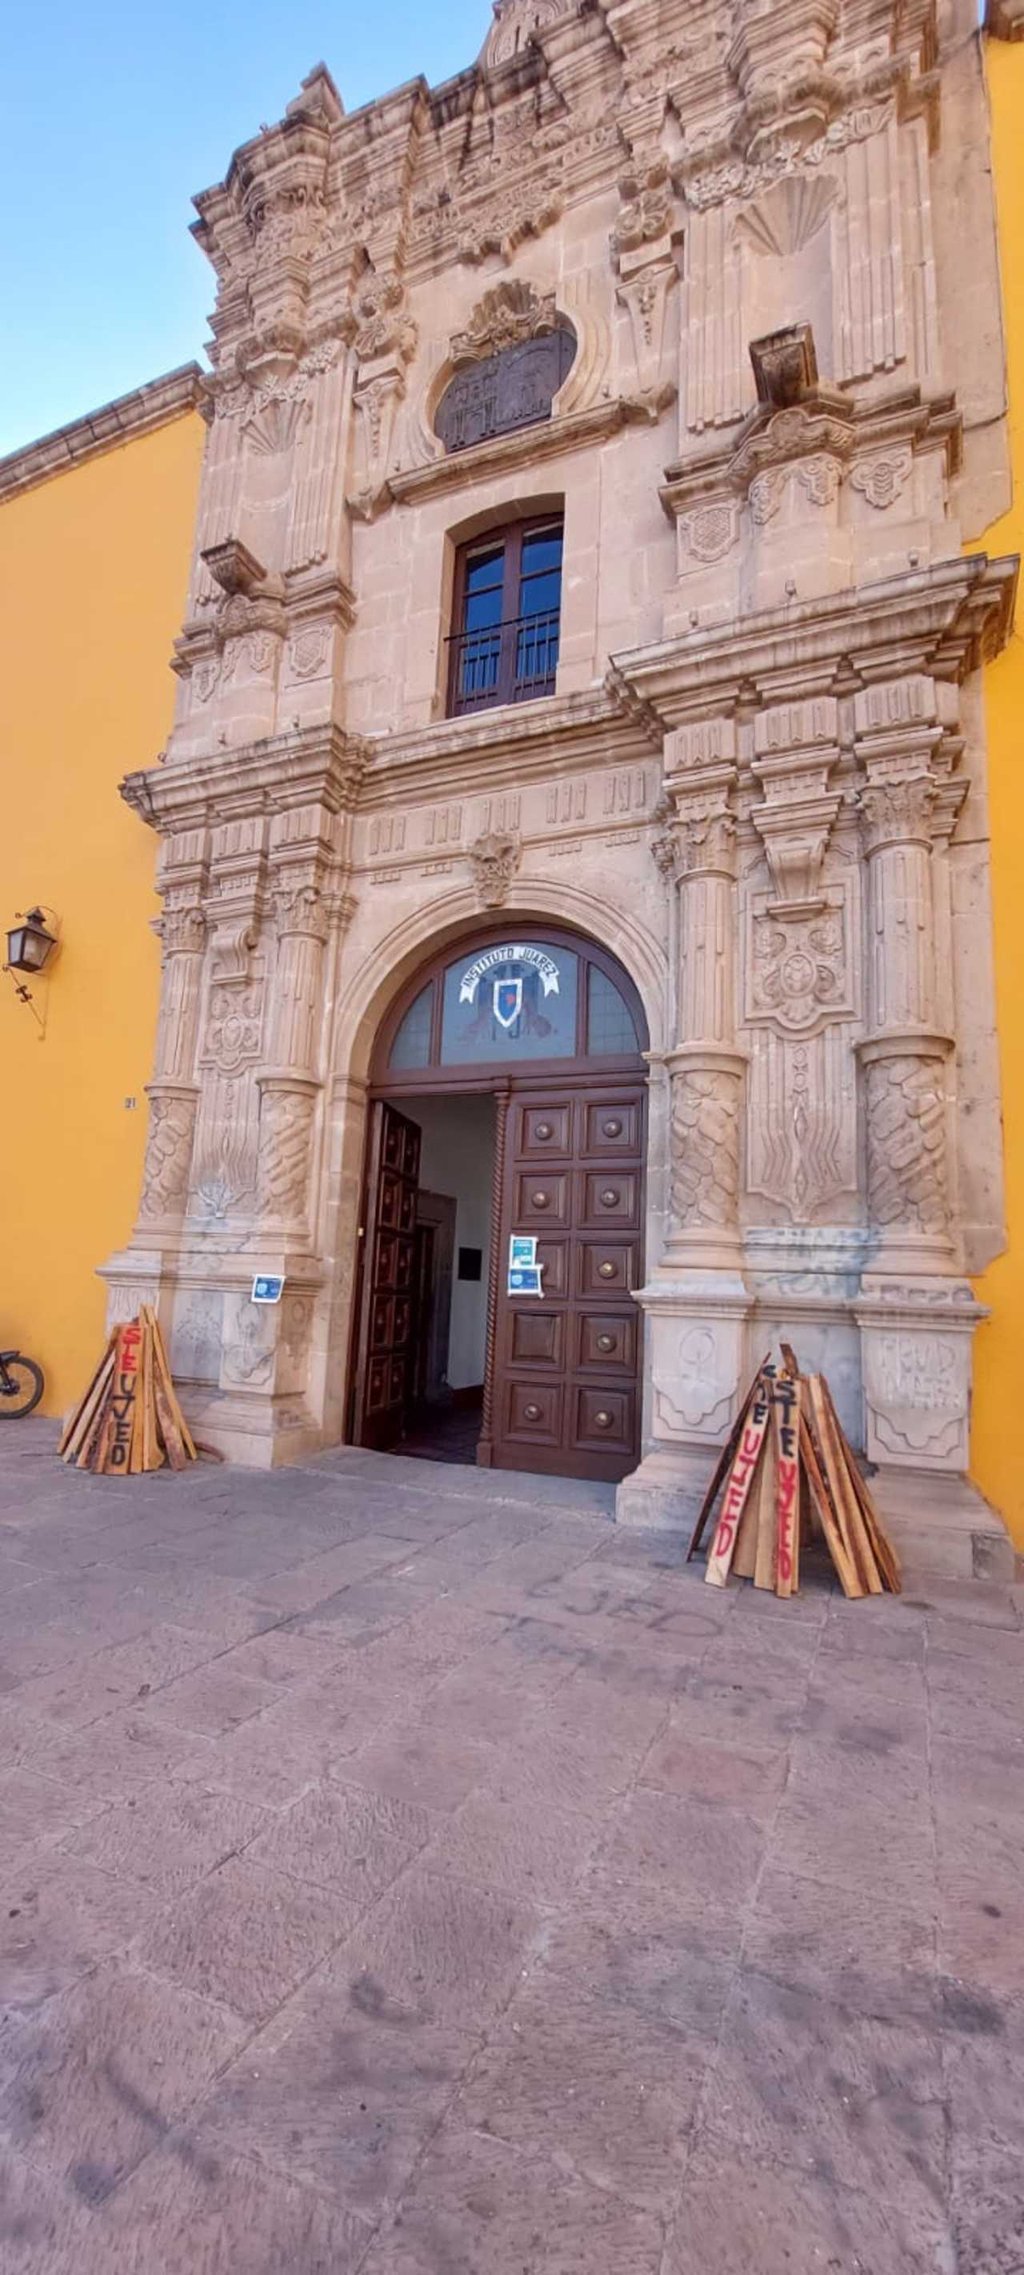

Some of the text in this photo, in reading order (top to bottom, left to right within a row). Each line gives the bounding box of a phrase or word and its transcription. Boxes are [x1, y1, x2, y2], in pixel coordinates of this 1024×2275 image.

[463, 948, 558, 988] INSTITUTO JUAREZ
[111, 1374, 137, 1466] UJED
[768, 1380, 797, 1581] STE UJED
